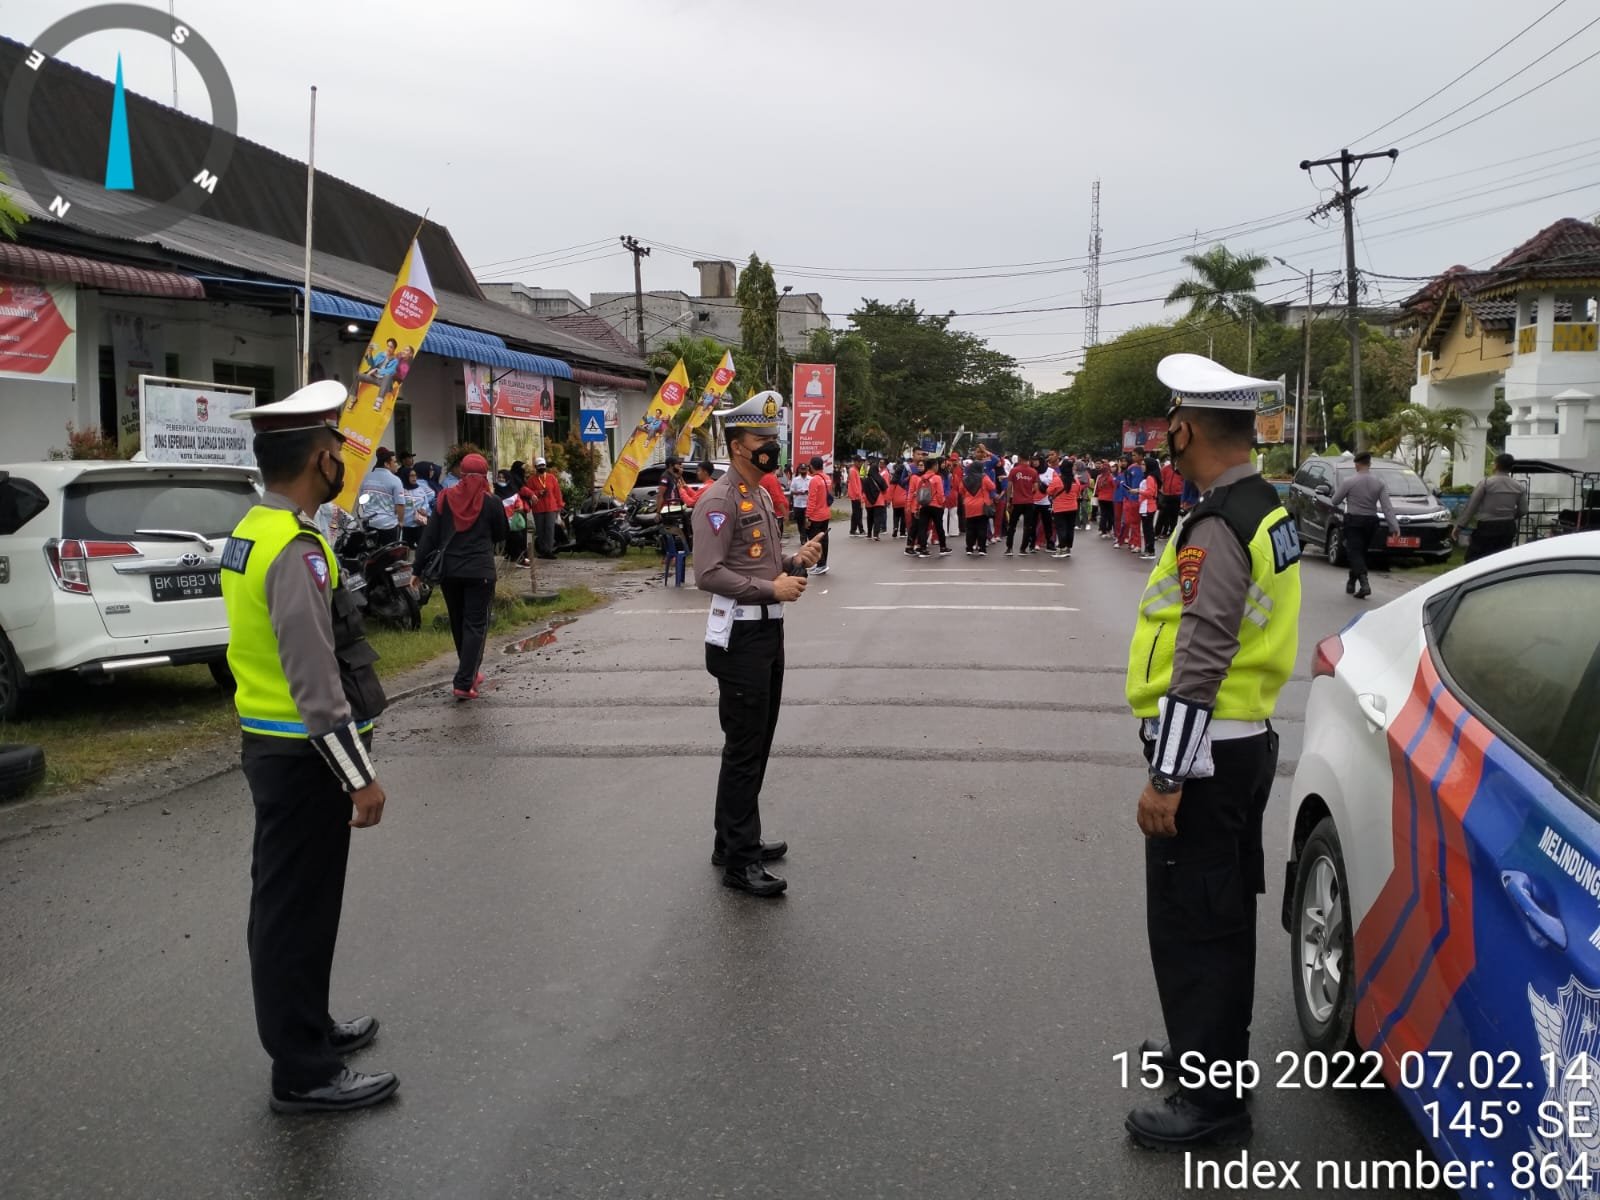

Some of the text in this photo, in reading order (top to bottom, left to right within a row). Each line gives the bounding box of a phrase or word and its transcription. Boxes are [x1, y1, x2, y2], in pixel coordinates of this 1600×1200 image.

[401, 289, 420, 304] IM3
[800, 409, 822, 434] 77
[154, 577, 173, 590] BK
[176, 574, 206, 588] 1683
